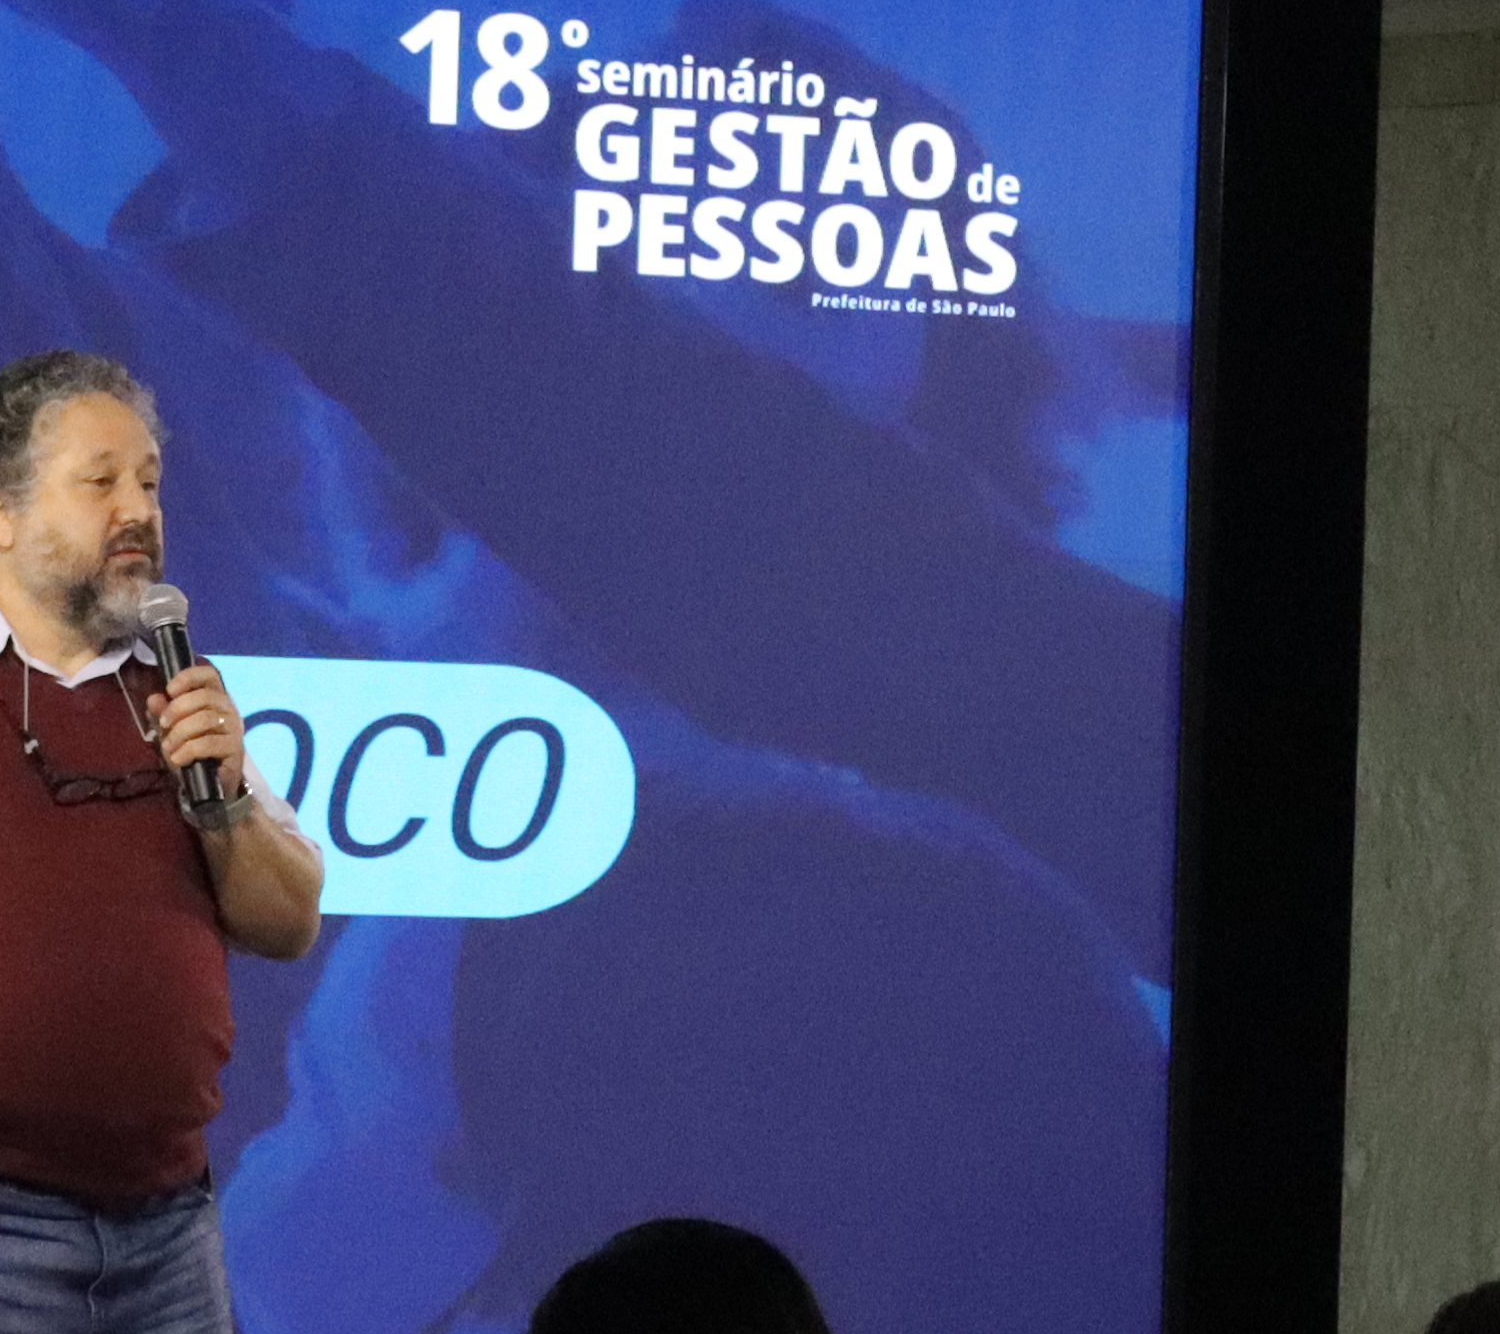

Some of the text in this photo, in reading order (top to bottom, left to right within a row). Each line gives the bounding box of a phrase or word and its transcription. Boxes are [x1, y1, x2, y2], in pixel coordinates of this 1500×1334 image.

[576, 54, 825, 108] seminário
[575, 96, 1021, 205] GESTÃO de
[572, 189, 1021, 295] PESSOAS
[811, 292, 1016, 318] Prefeitura de São Paulo
[243, 708, 566, 863] CO
